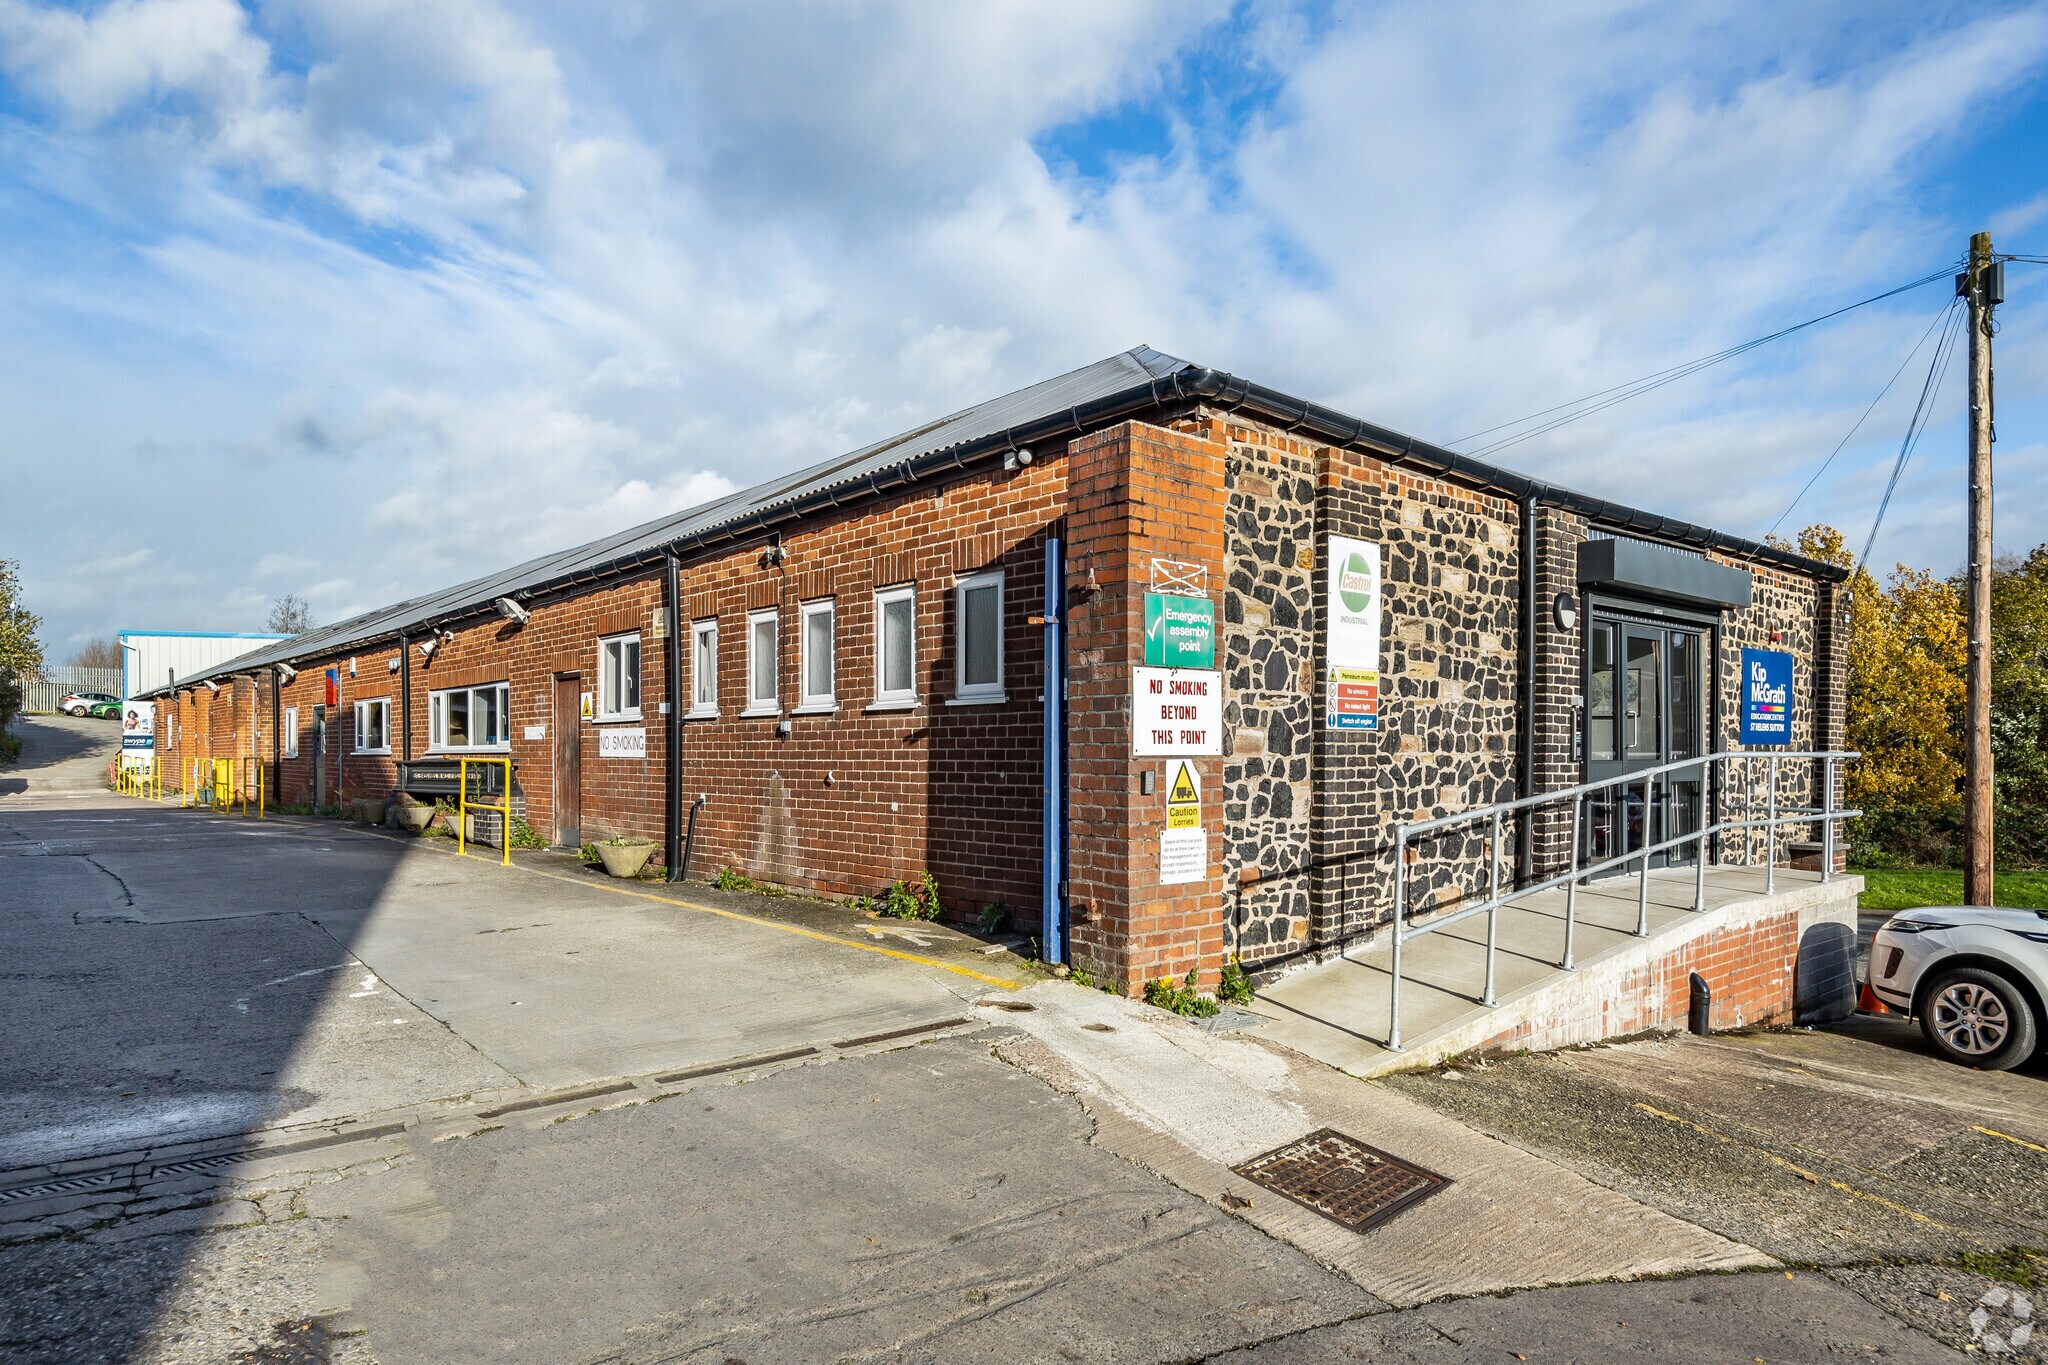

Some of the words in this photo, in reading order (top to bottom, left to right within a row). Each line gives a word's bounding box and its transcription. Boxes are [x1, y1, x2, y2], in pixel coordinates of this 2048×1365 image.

[1343, 573, 1371, 592] Castrol
[1166, 609, 1211, 625] Emergency
[1340, 616, 1368, 625] INDUSTRIAL
[1170, 626, 1209, 639] assembly
[1179, 641, 1200, 653] point
[1751, 661, 1766, 688] Kip
[1150, 679, 1162, 694] NO
[1169, 680, 1207, 696] SMOKING
[1353, 689, 1369, 697] smoking
[1751, 682, 1785, 703] McGrath
[1161, 705, 1197, 720] BEYOND
[601, 736, 609, 749] NO
[613, 736, 644, 750] SMOKING
[1151, 730, 1173, 744] THIS
[1181, 730, 1206, 744] POINT
[1170, 807, 1197, 817] Caution
[1173, 818, 1194, 826] Lorries
